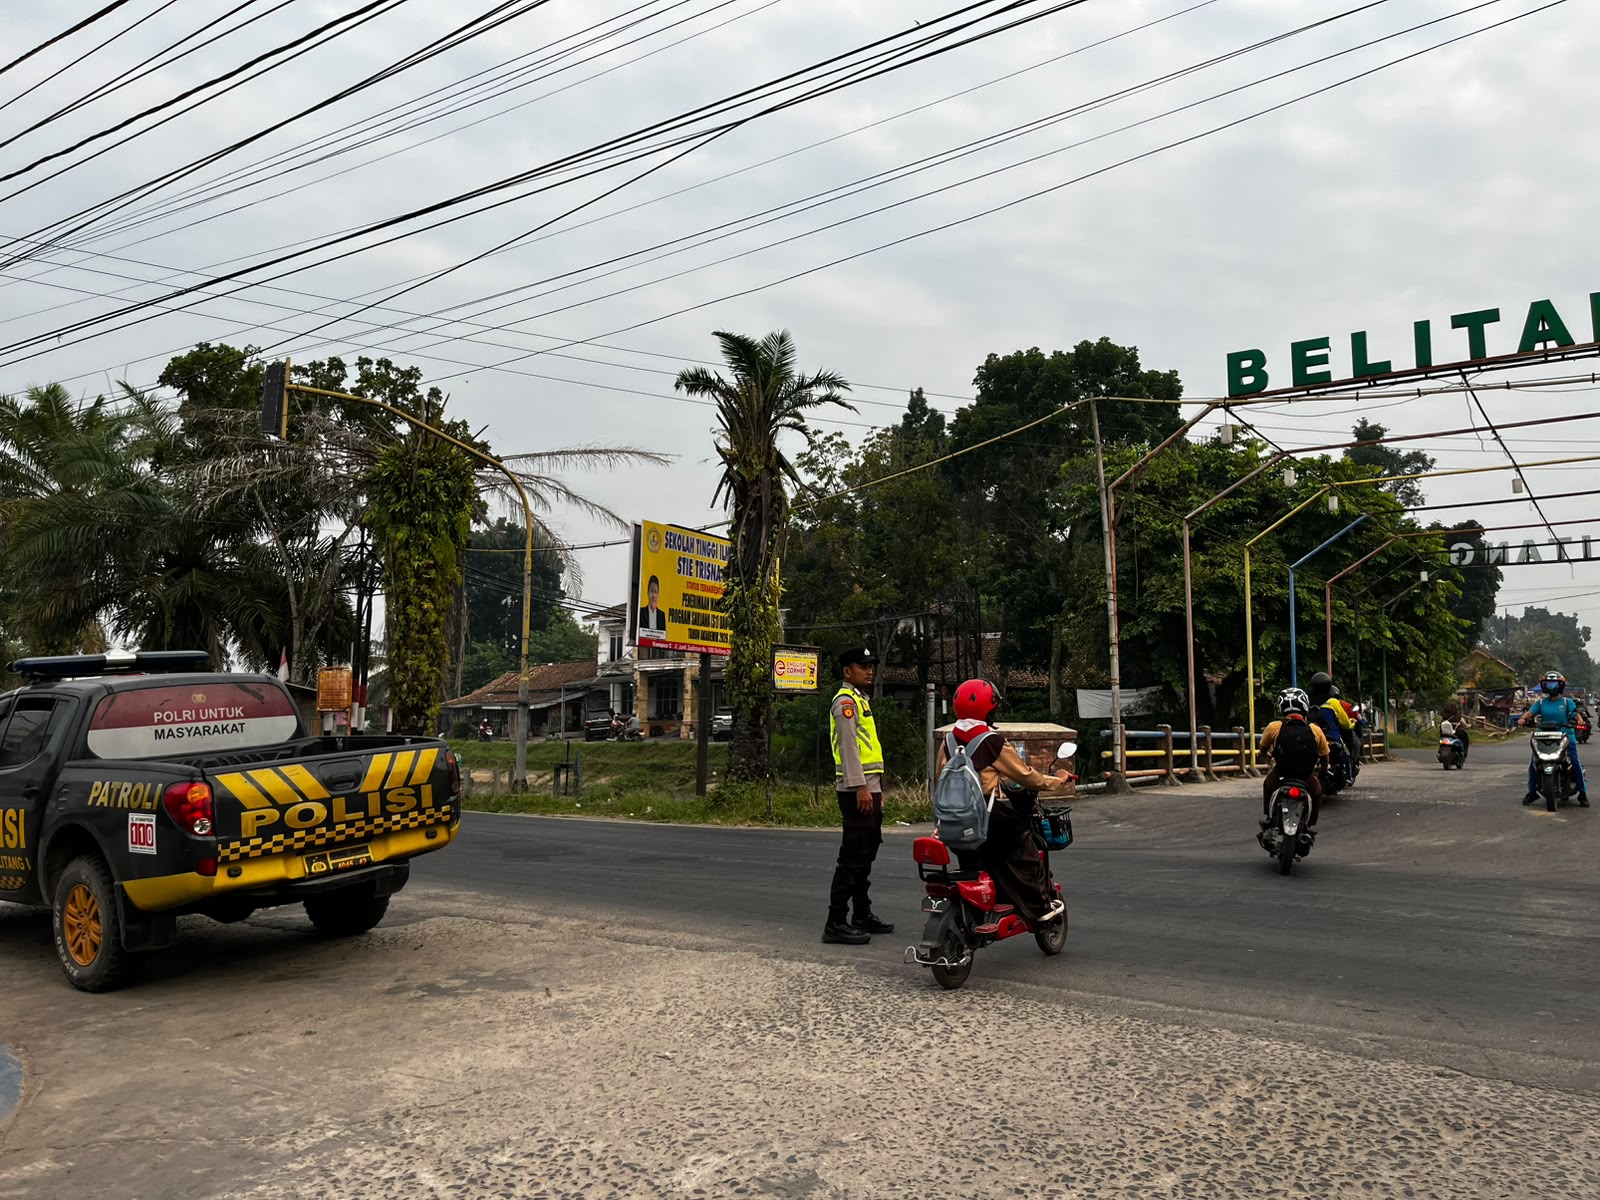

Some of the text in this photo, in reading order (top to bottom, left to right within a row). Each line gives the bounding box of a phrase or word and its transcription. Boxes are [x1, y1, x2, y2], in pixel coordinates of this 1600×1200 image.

[665, 530, 731, 561] SEKOLAH TINGGI ILM
[677, 556, 693, 577] STIE
[153, 706, 244, 724] POLRI UNTUK
[154, 722, 246, 741] MASYARAKAT
[87, 781, 163, 810] PATROLI
[240, 784, 433, 838] POLISI
[131, 825, 153, 845] 110
